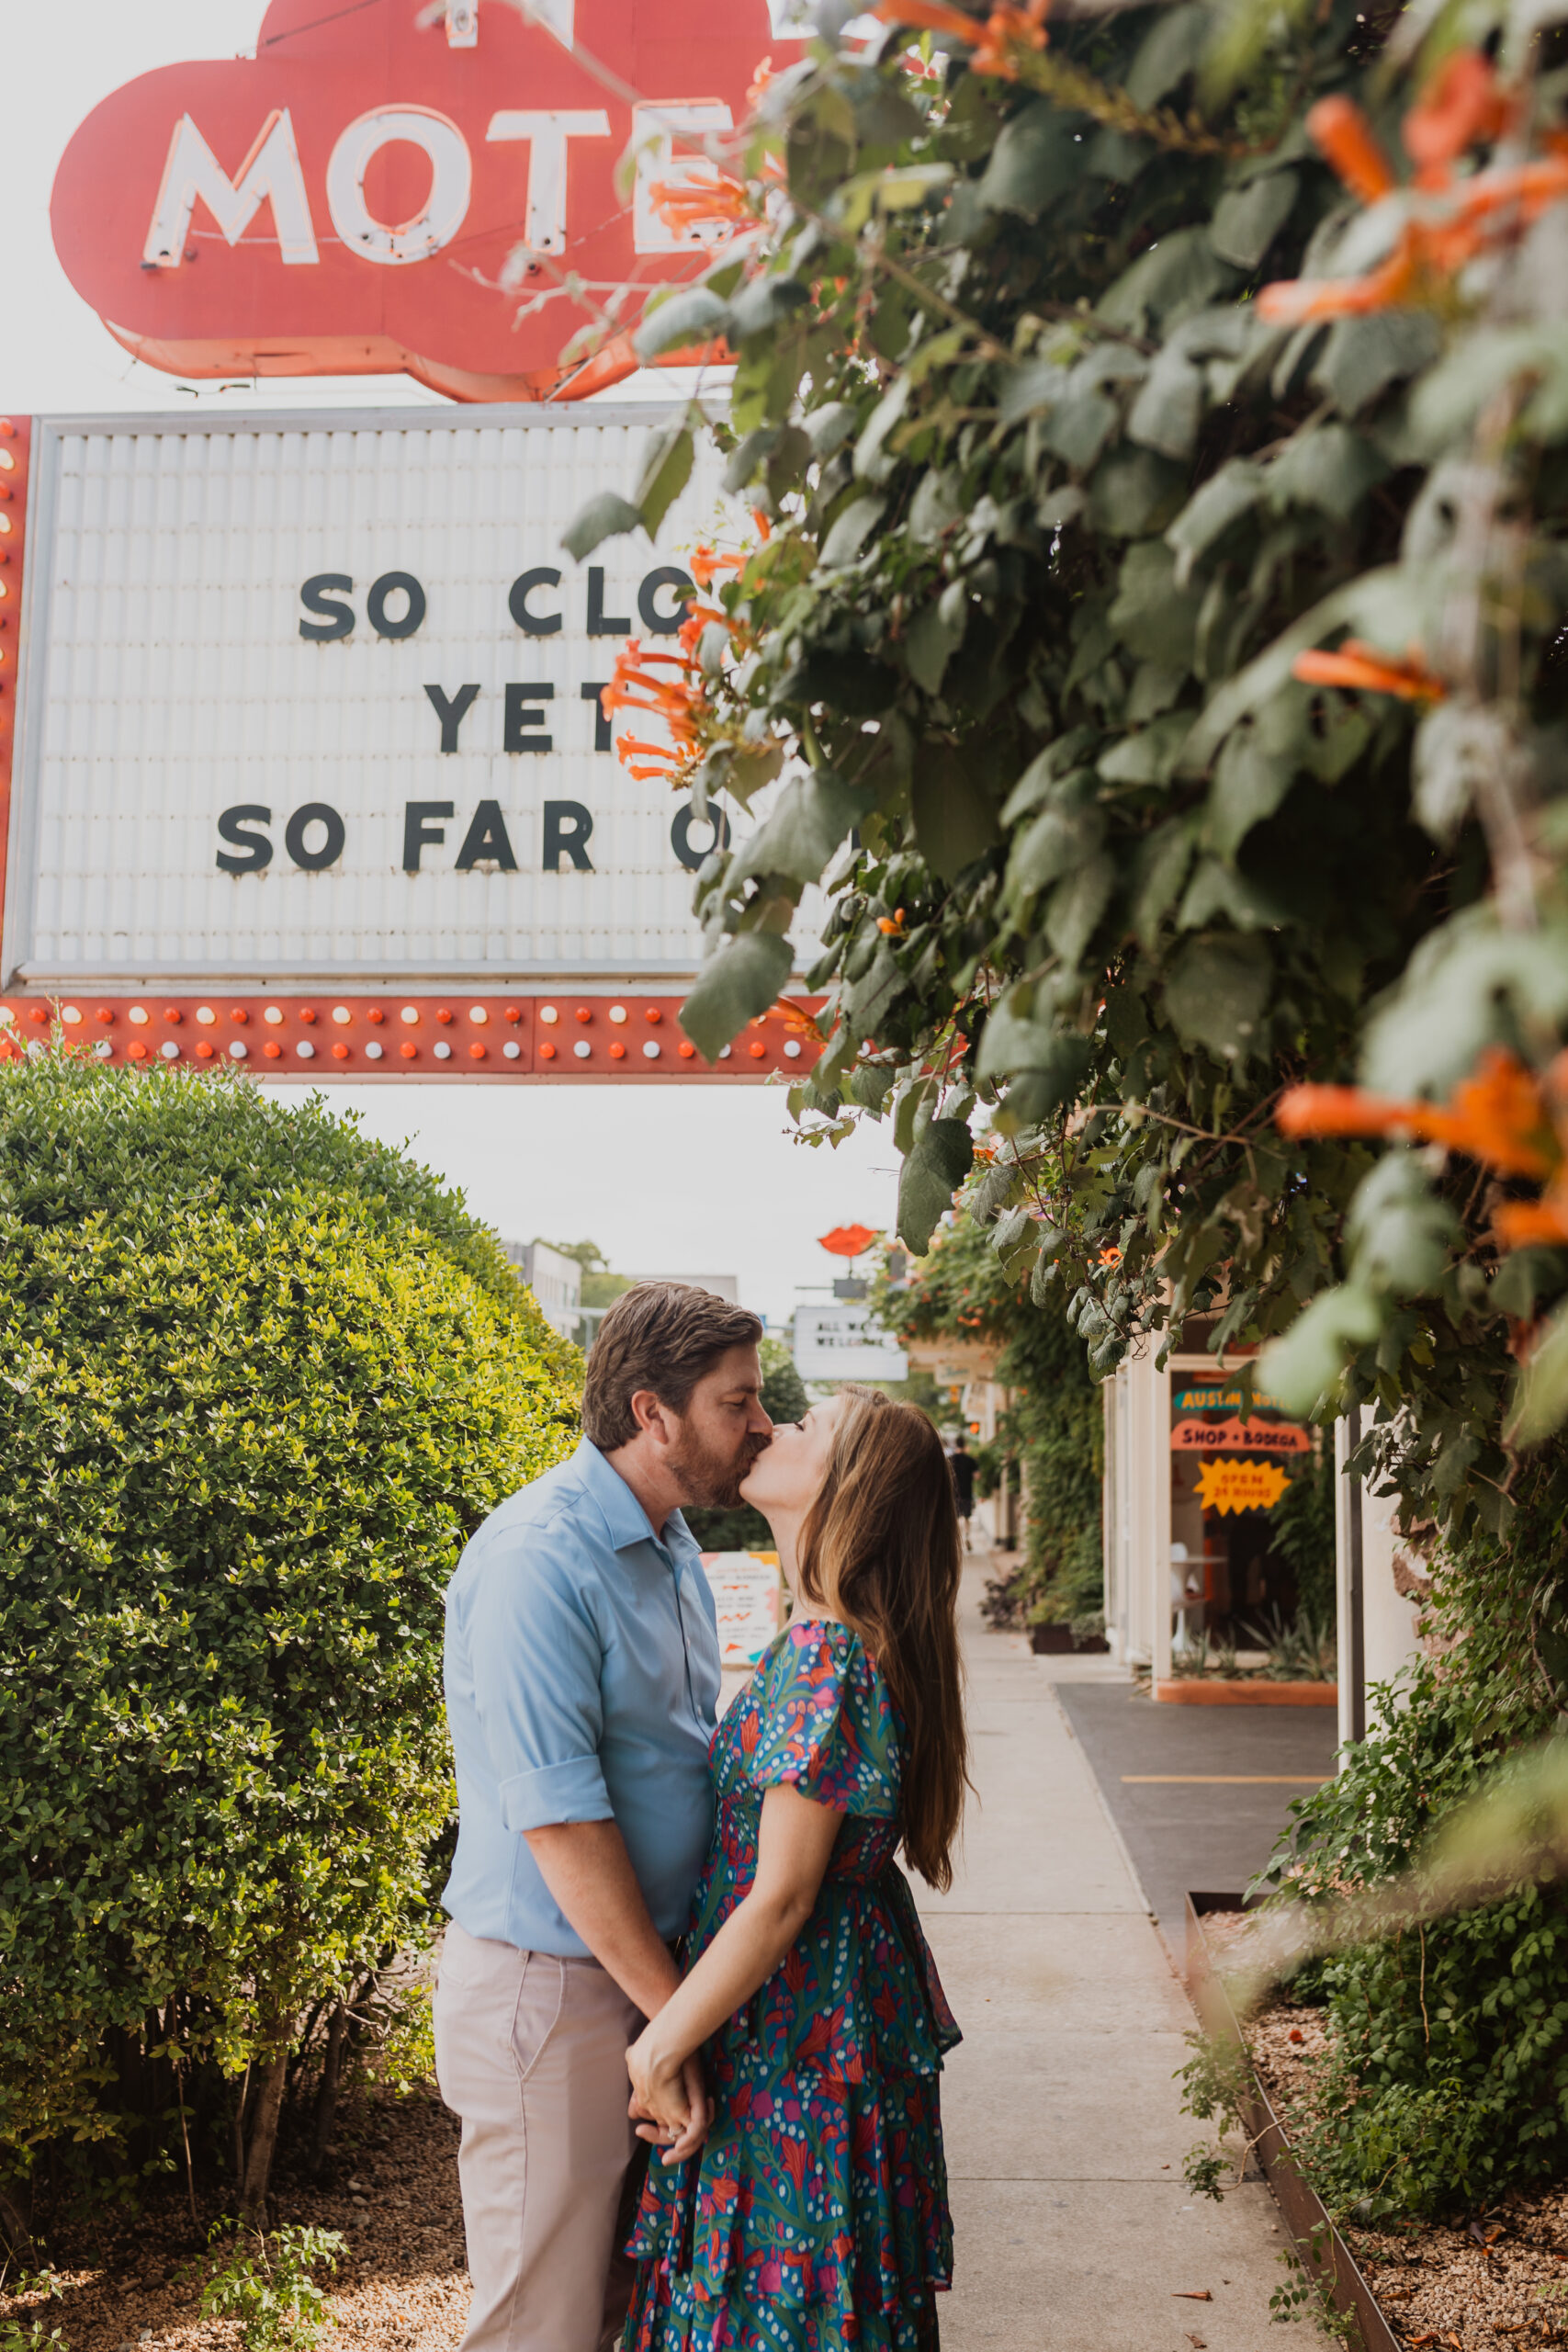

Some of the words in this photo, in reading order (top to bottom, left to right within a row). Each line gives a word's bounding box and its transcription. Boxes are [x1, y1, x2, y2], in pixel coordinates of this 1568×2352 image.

[143, 99, 781, 266] MOTE
[299, 571, 426, 641] SO
[423, 683, 628, 753] YET
[216, 802, 345, 872] SO
[402, 799, 595, 871] FAR
[1182, 1429, 1227, 1444] SHOP
[1244, 1430, 1298, 1447] BODEGA
[1220, 1474, 1264, 1485] OPEN
